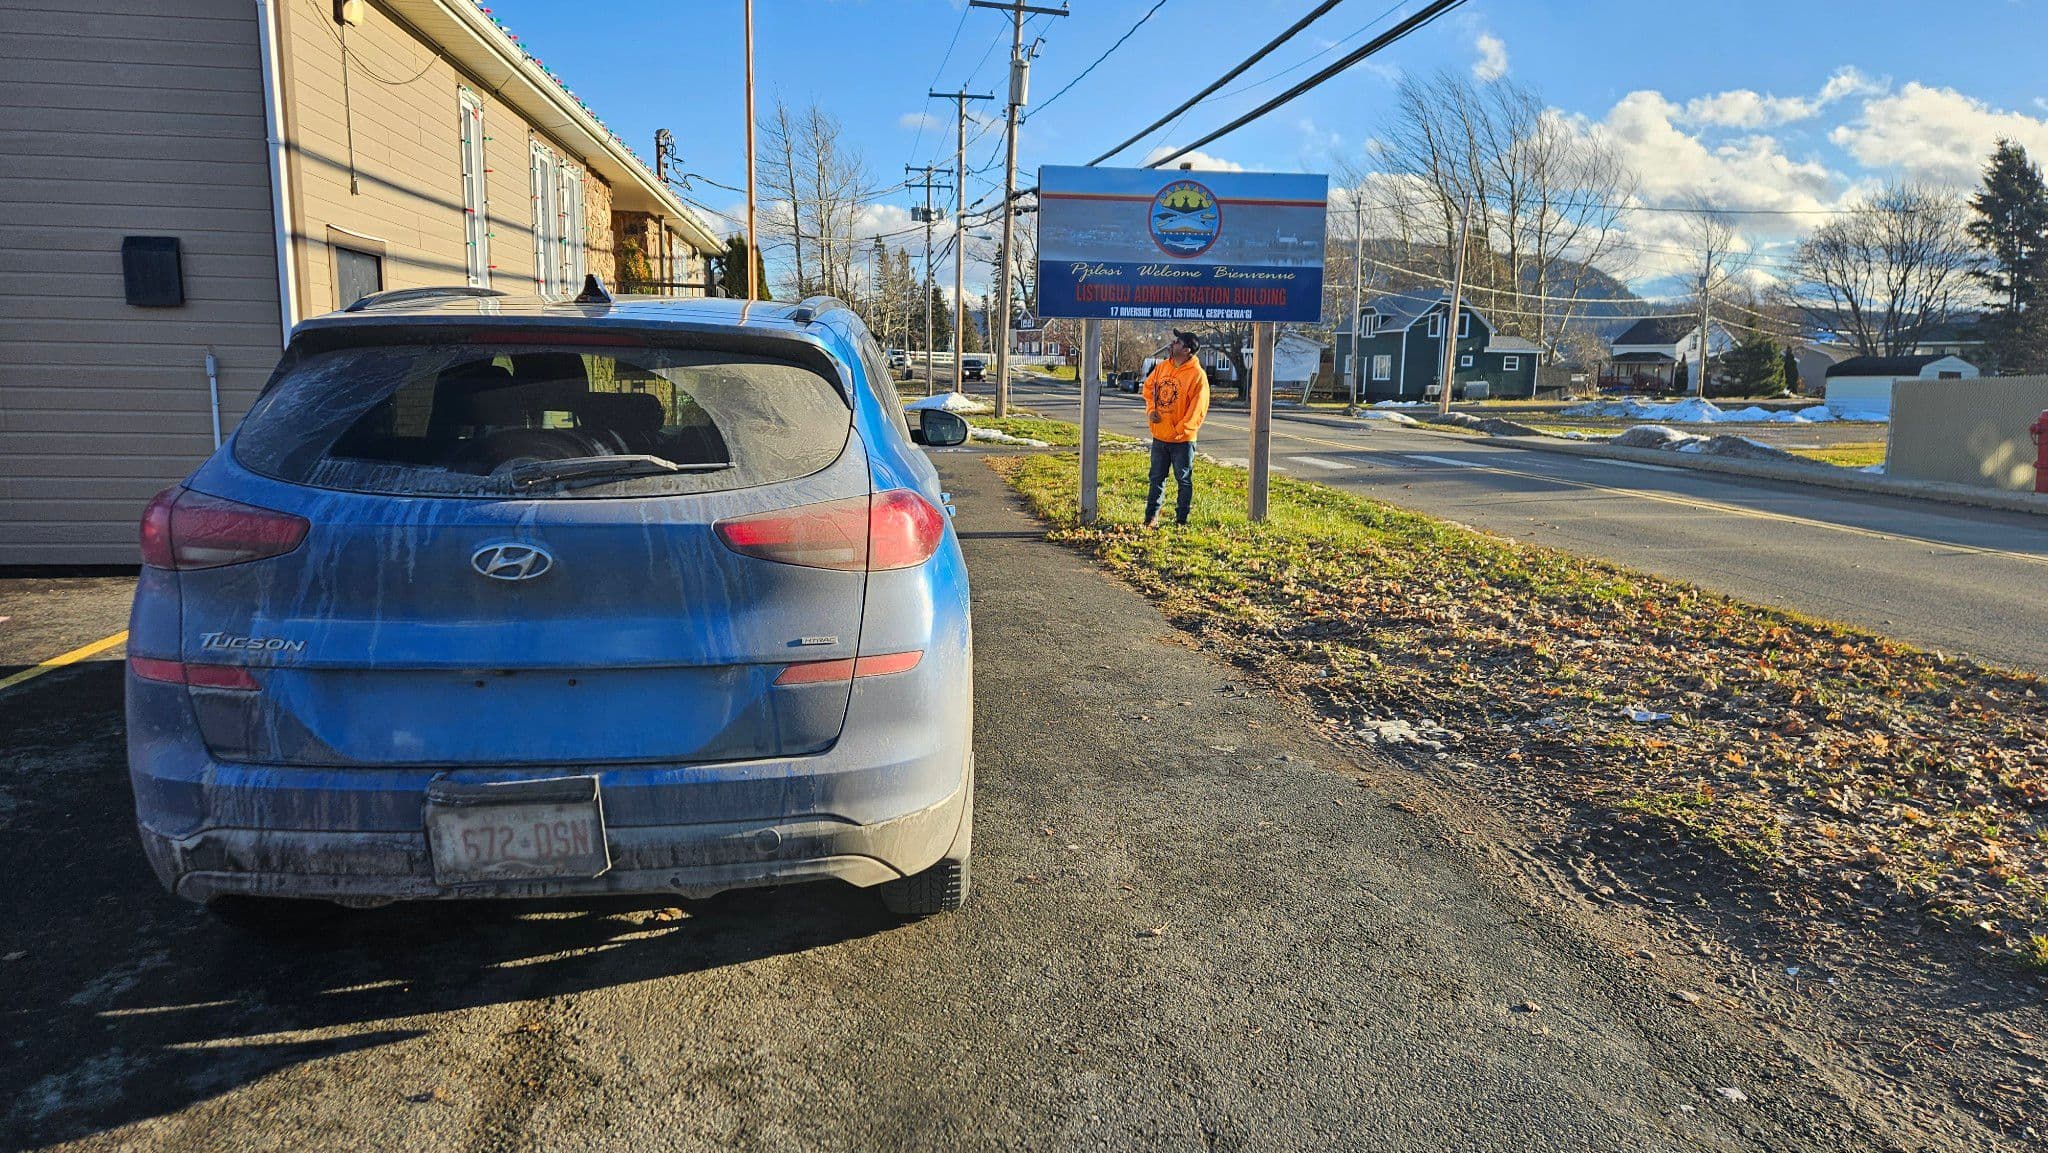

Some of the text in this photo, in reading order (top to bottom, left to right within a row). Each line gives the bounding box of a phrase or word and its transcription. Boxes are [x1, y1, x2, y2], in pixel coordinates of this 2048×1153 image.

[1136, 264, 1202, 278] Welcome
[1213, 265, 1297, 280] Bienvenue
[1075, 284, 1287, 305] LISTUGUJ ADMINISTRATION BUILDING
[1110, 306, 1119, 317] 17
[1120, 307, 1152, 317] RIVERSIDE
[1152, 308, 1172, 318] WEST,
[1173, 308, 1204, 319] LISTUGUJ,
